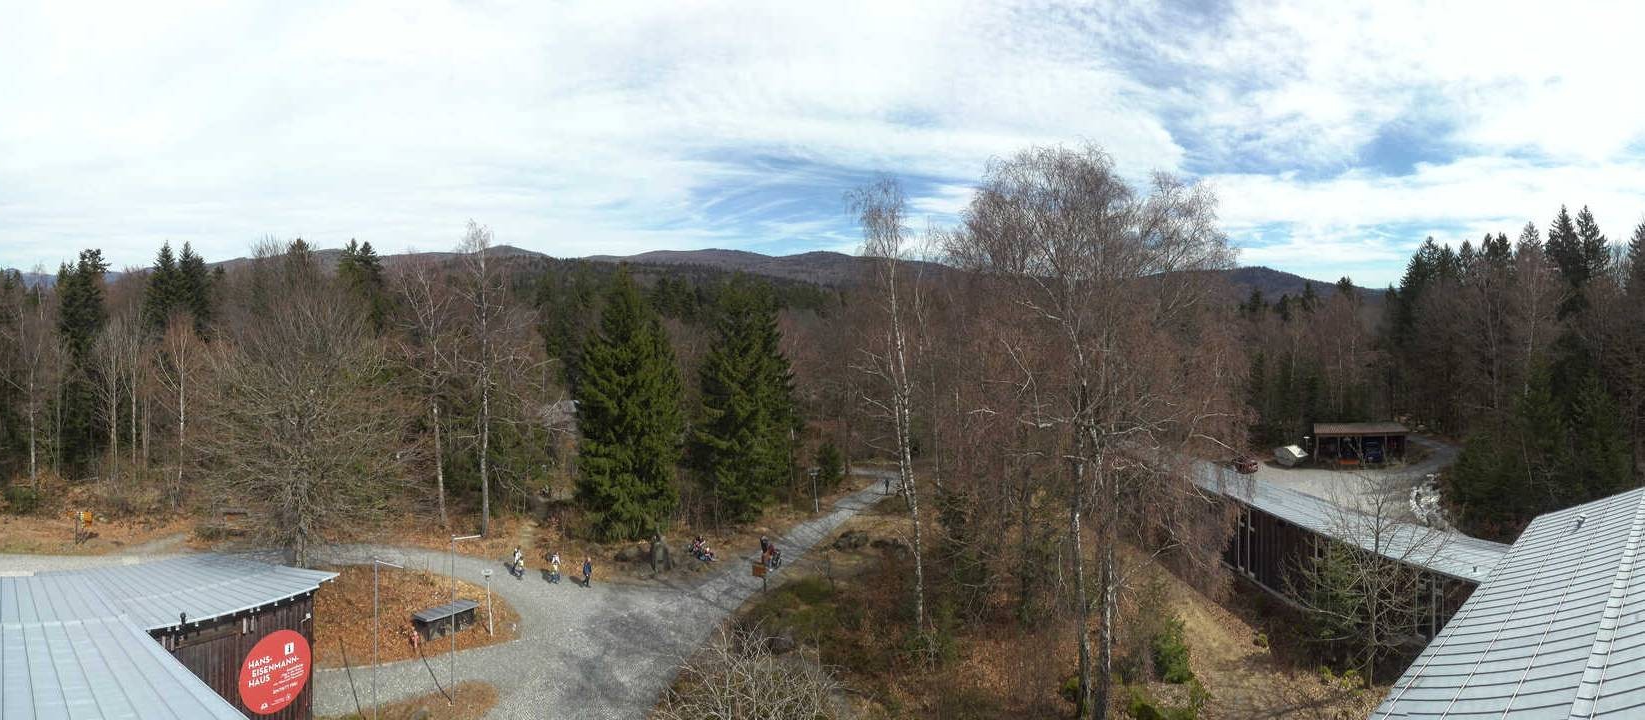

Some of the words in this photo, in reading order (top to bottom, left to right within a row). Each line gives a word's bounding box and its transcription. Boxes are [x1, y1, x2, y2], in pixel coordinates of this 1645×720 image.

[248, 656, 272, 669] HANS-
[251, 656, 299, 677] EISENMANN-
[248, 675, 270, 688] HAUS
